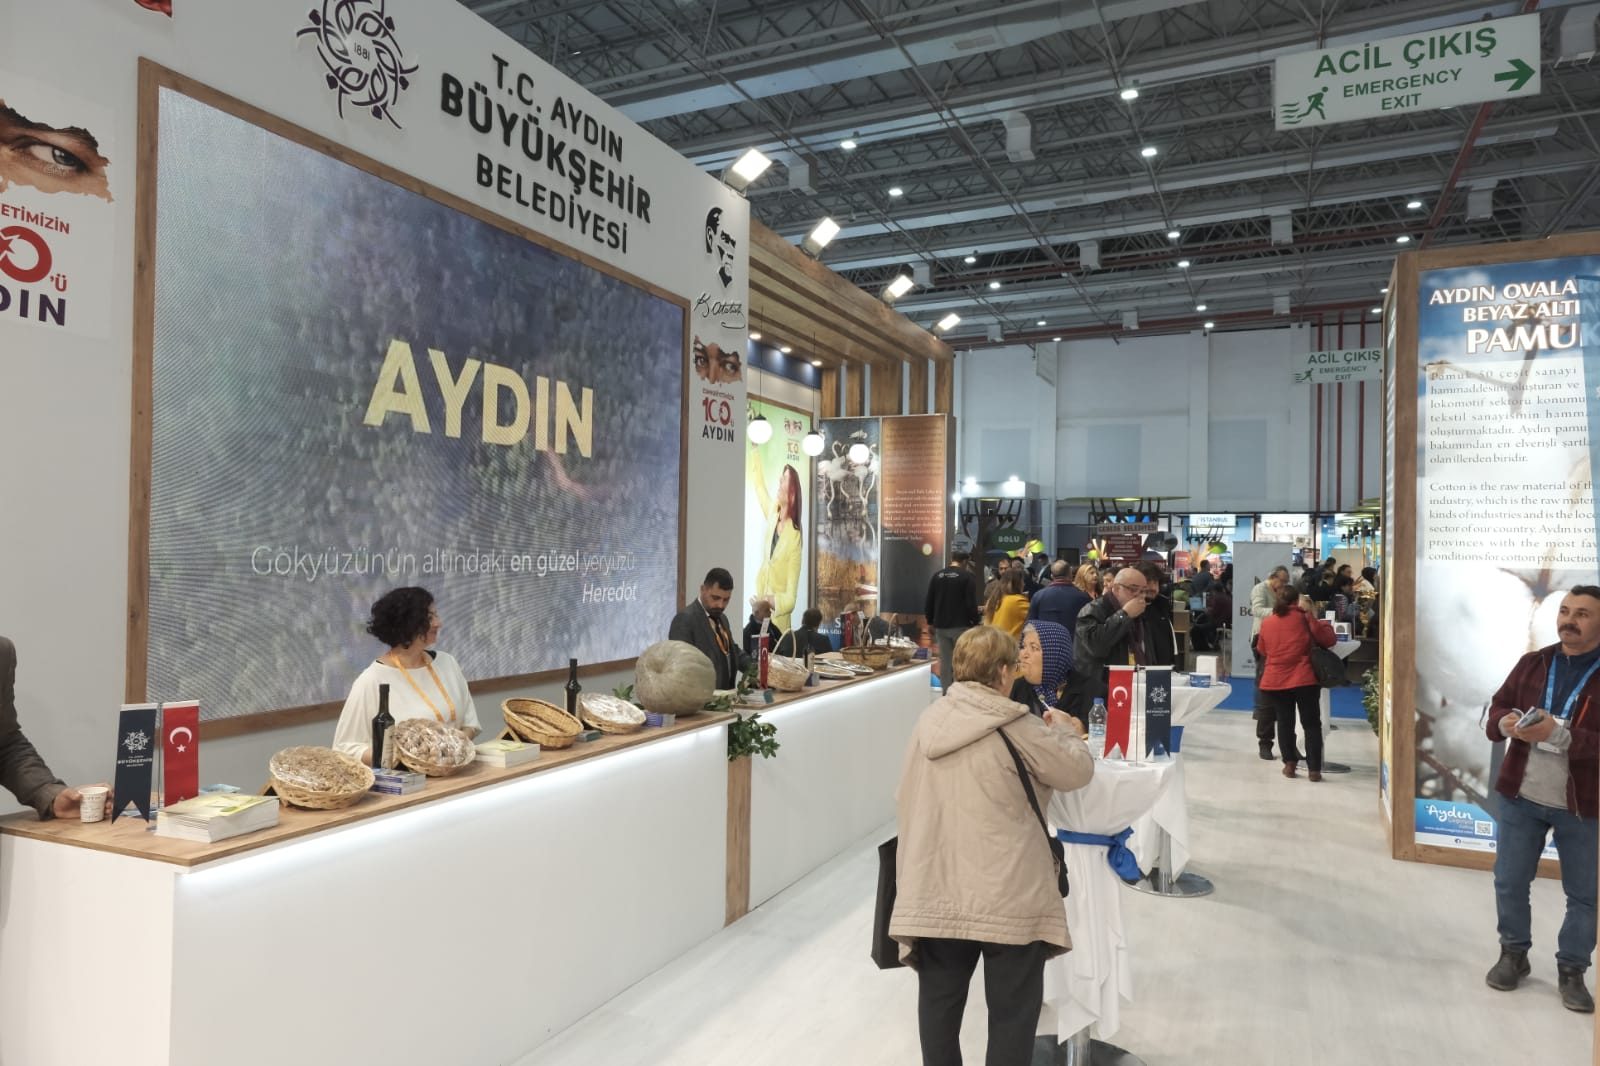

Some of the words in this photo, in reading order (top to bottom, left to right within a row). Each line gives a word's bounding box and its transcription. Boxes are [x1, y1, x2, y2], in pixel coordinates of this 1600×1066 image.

[1314, 43, 1392, 79] ACİL
[1402, 27, 1497, 69] ÇIKIŞ
[1343, 68, 1462, 98] EMERGENCY
[1381, 93, 1422, 111] EXIT
[550, 96, 623, 163] AYDIN
[441, 72, 652, 223] BÜYÜKŞEHİR
[476, 152, 627, 255] BELEDİYESİ
[1429, 285, 1496, 305] AYDIN
[1463, 302, 1530, 323] BEYAZ
[1308, 352, 1340, 364] ACİL
[1343, 350, 1381, 364] ÇIKIŞ
[1319, 365, 1368, 374] EMERGENCY
[363, 338, 594, 458] AYDIN
[702, 424, 735, 443] AYDIN
[1429, 482, 1466, 491] Cotton
[1469, 482, 1477, 491] is
[1480, 482, 1497, 491] the
[1500, 483, 1519, 491] raw
[1522, 481, 1566, 491] material
[1569, 481, 1582, 490] of
[1476, 495, 1508, 505] which
[1510, 496, 1518, 505] is
[1521, 495, 1538, 505] the
[1541, 497, 1560, 505] raw
[1429, 509, 1457, 519] kinds
[1458, 509, 1470, 519] of
[1470, 509, 1522, 519] industries
[1523, 509, 1544, 519] and
[1545, 510, 1554, 519] is
[1555, 509, 1573, 519] the
[1429, 524, 1460, 533] sector
[1461, 523, 1472, 533] of
[1473, 525, 1491, 533] our
[1573, 524, 1581, 533] is
[998, 535, 1020, 543] BOLU
[1428, 538, 1484, 549] provinces
[1490, 538, 1515, 548] with
[1521, 538, 1540, 548] the
[1545, 540, 1575, 548] most
[251, 544, 416, 582] Gökyüzünün
[422, 547, 505, 574] altındaki
[510, 553, 532, 572] en
[537, 548, 579, 577] güzel
[1428, 552, 1483, 561] conditions
[1484, 552, 1499, 561] for
[1501, 553, 1536, 562] cotton
[582, 582, 638, 603] Heredot
